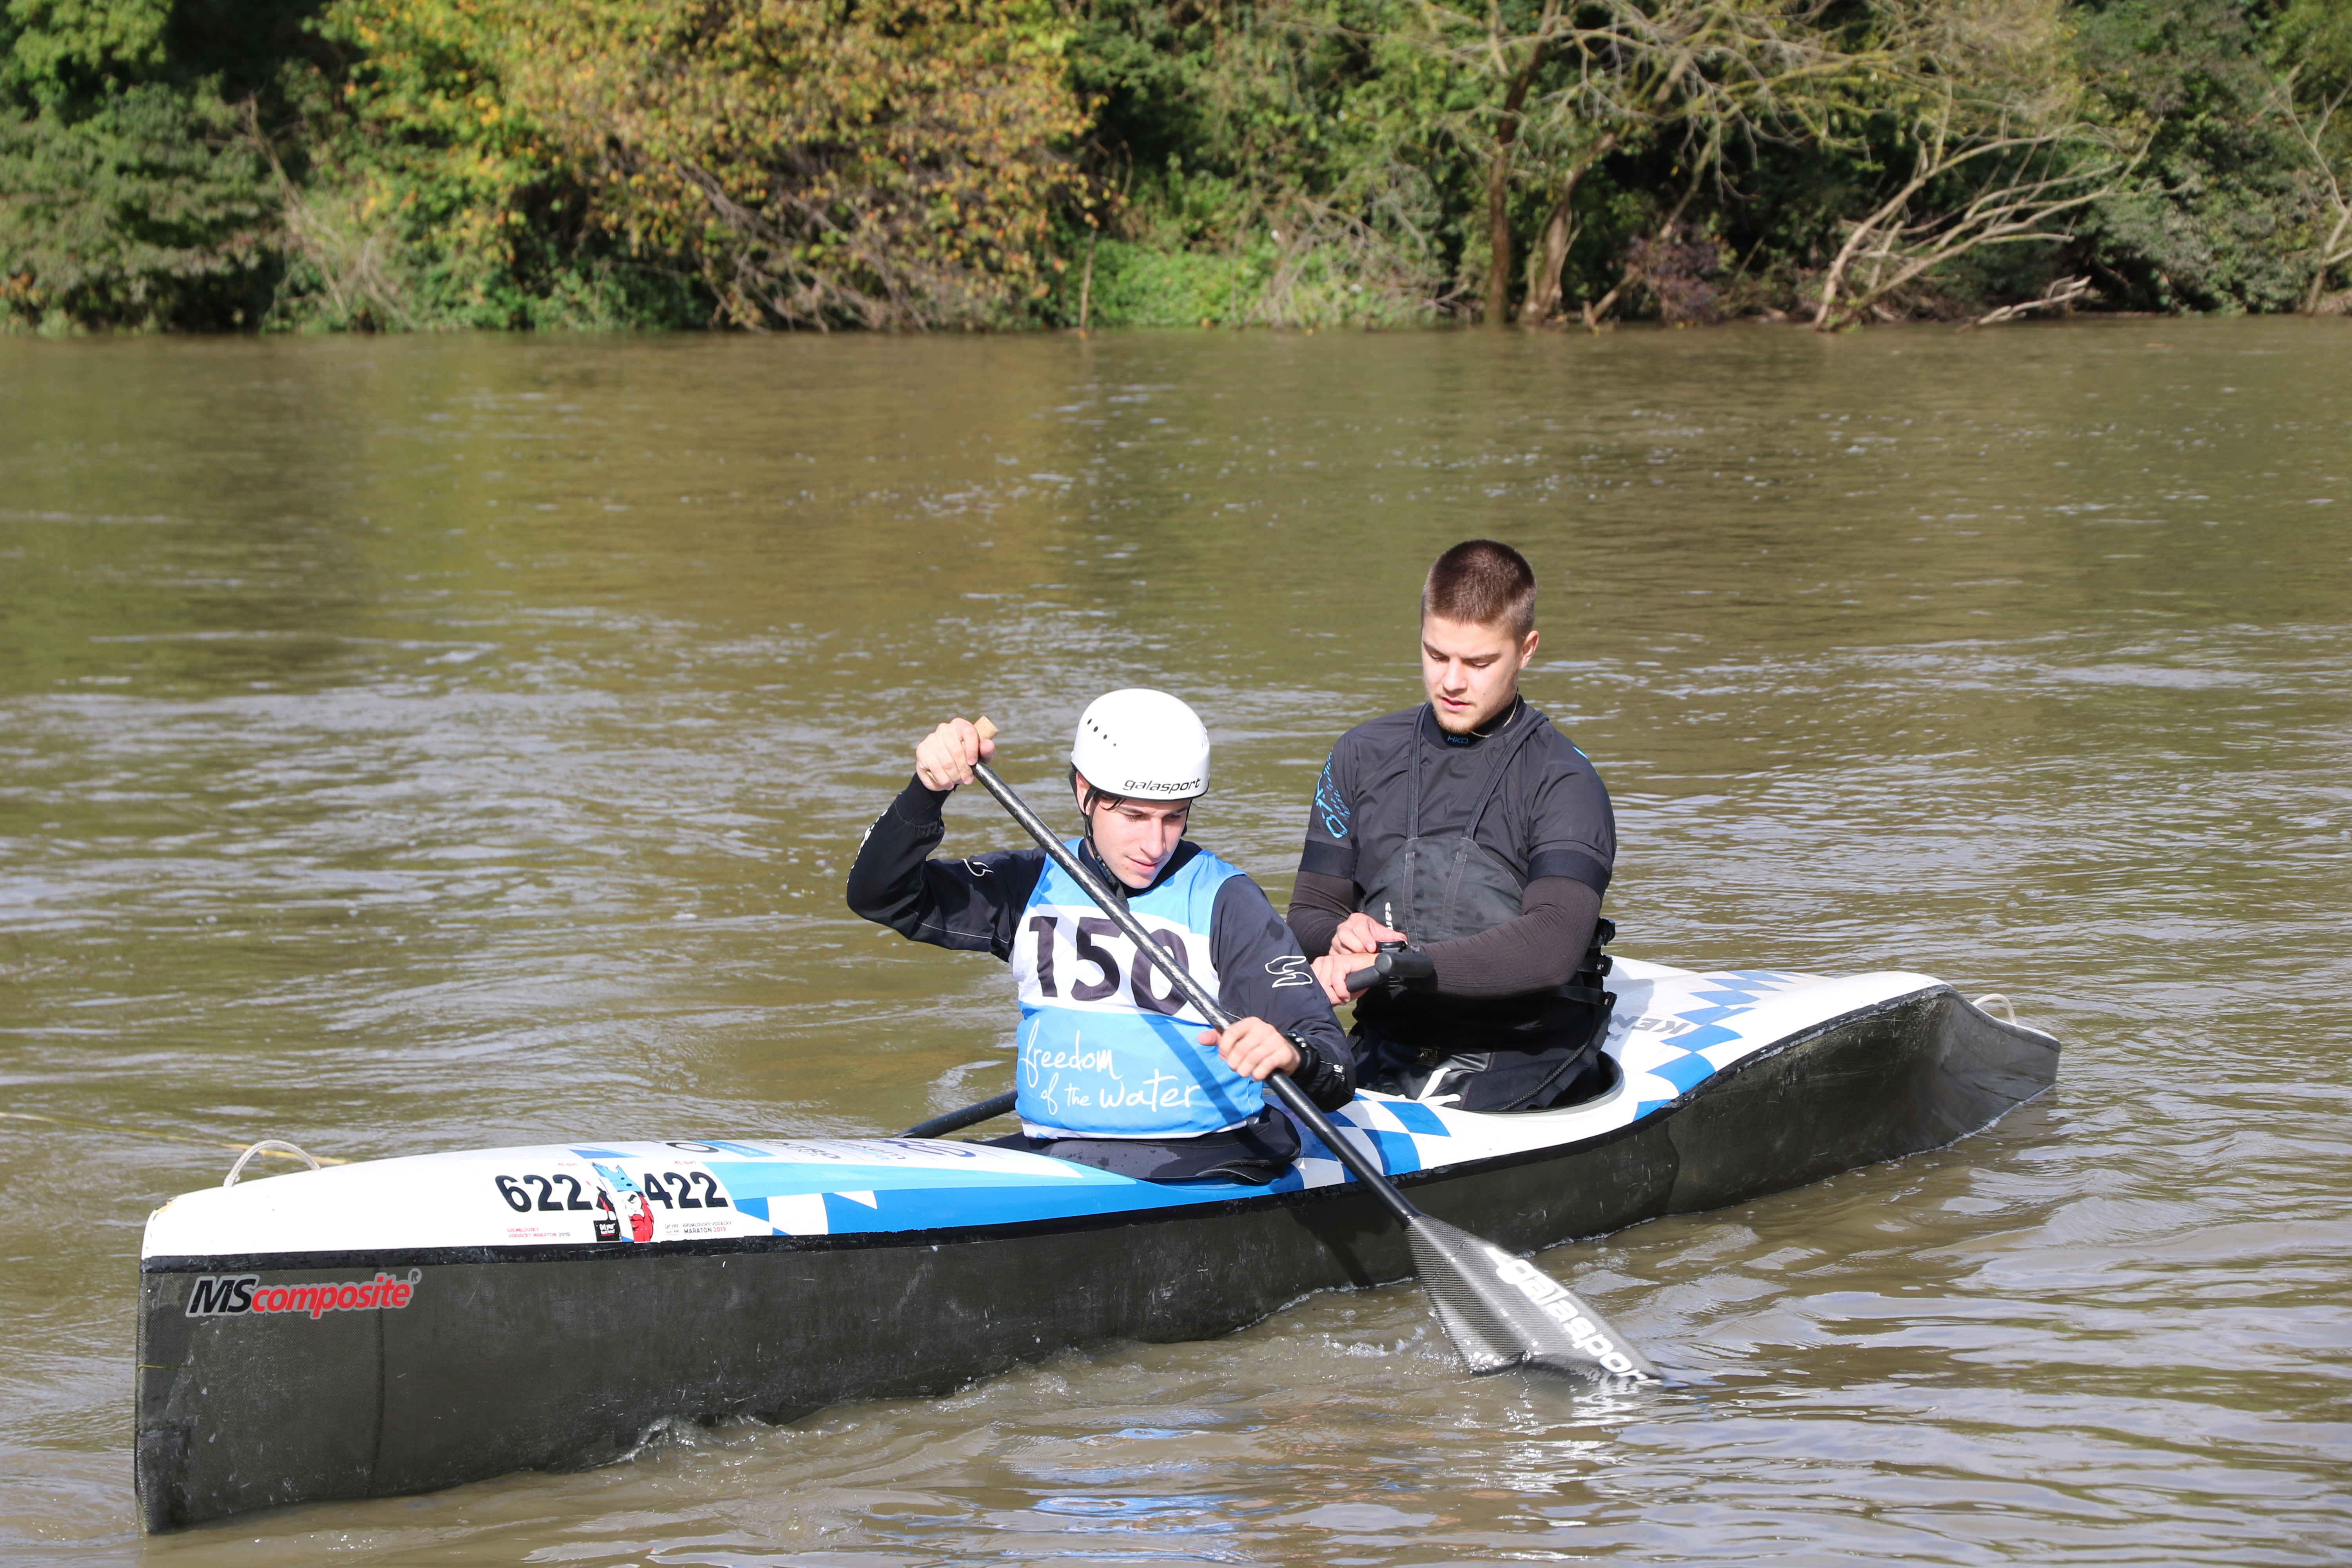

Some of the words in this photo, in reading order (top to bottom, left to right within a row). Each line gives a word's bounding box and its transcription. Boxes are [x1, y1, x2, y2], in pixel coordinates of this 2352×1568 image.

[1122, 777, 1201, 794] galasport
[1029, 916, 1189, 1016] 150
[1019, 1018, 1125, 1088] freedom
[1039, 1072, 1059, 1115] of
[1064, 1082, 1093, 1107] the
[495, 1174, 593, 1212] 622
[644, 1172, 729, 1209] 422
[1485, 1247, 1663, 1386] galaspor
